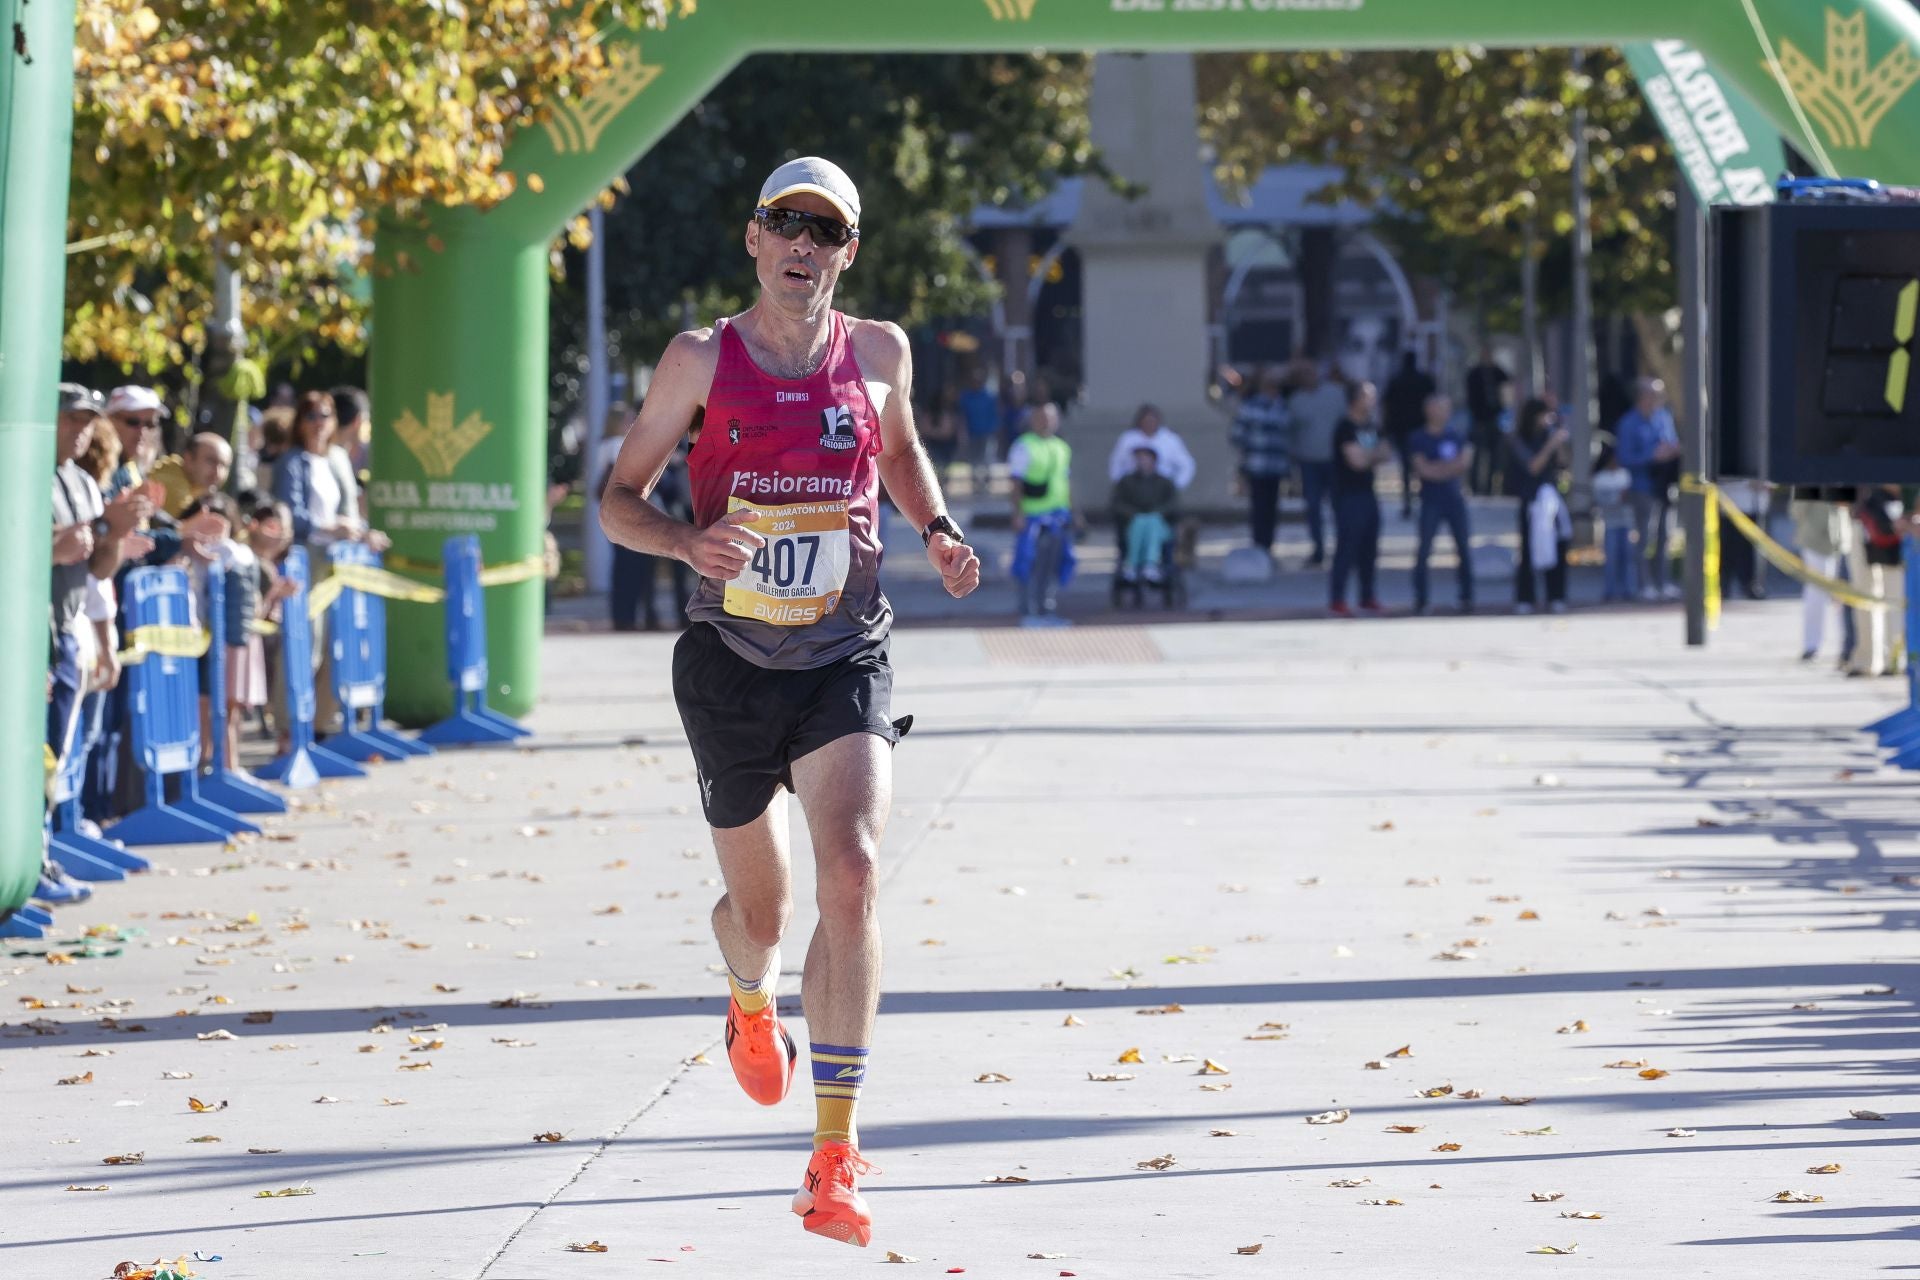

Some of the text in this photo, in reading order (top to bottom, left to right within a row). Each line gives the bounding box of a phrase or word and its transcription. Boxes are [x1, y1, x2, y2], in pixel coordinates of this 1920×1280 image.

[731, 471, 852, 495] Fisiorama
[776, 504, 816, 518] MARATÓN
[818, 501, 846, 514] AVILÉS
[771, 520, 796, 532] 2024
[752, 536, 820, 587] 407
[756, 582, 817, 598] GUILLERMO GARCÍA
